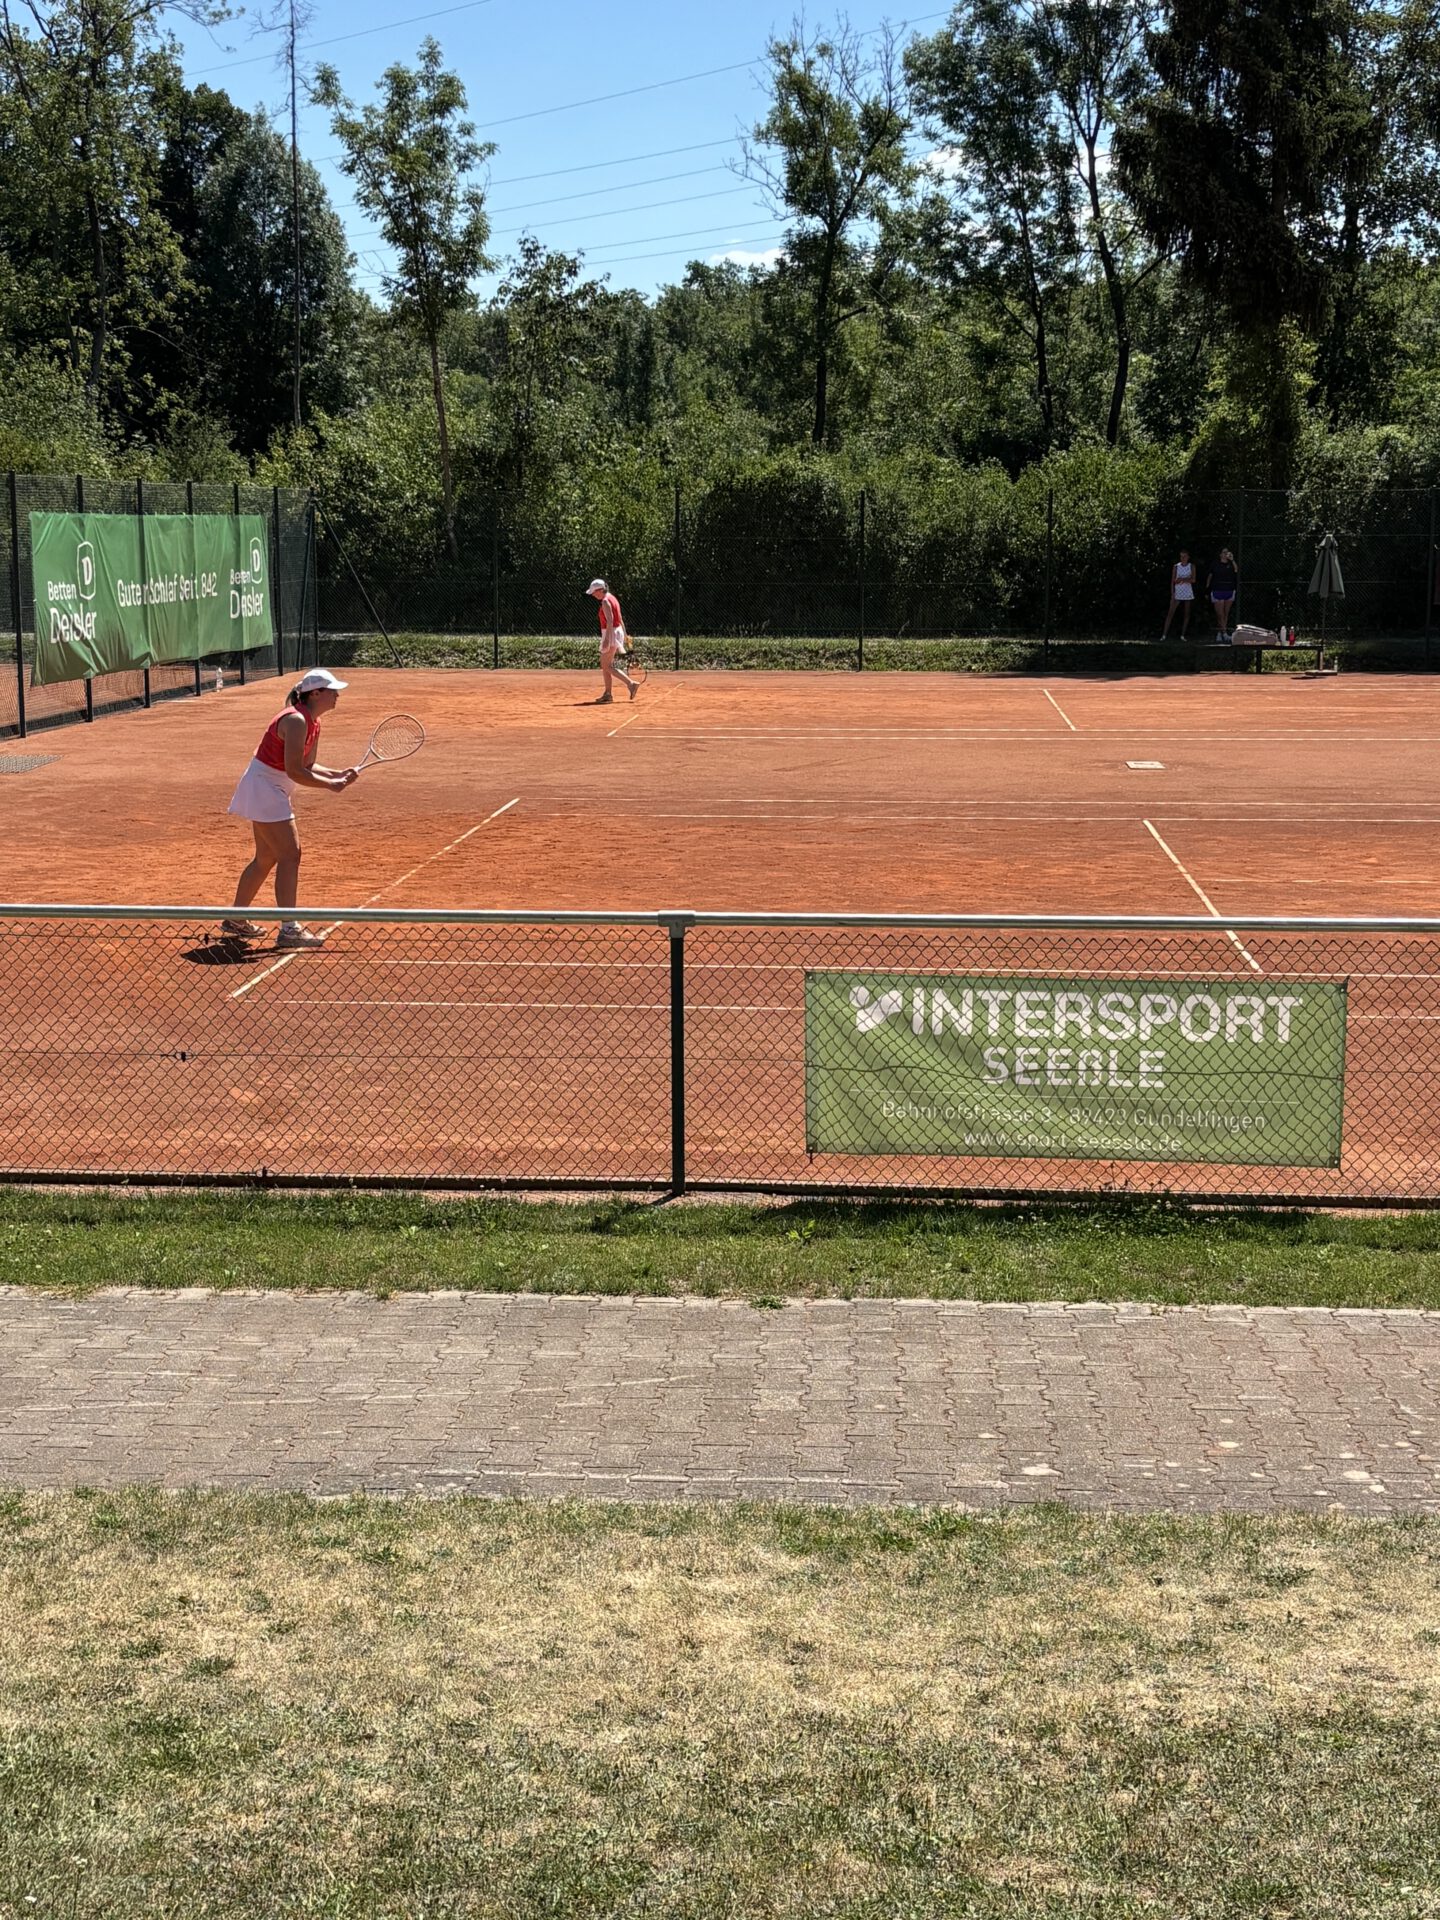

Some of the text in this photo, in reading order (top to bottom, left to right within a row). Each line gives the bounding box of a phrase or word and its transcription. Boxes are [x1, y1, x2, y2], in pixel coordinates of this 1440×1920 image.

[48, 580, 78, 601] Betten
[117, 579, 149, 607] Guter
[149, 573, 178, 605] Schlaf
[179, 573, 199, 601] Seit
[230, 569, 251, 585] Been
[50, 603, 97, 644] Deisler
[911, 987, 1303, 1044] INTERSPORT
[882, 1101, 1035, 1123] Bahnhofstrasse
[1068, 1107, 1128, 1126] 89423
[1134, 1108, 1266, 1133] Gundelfingen
[963, 1132, 1183, 1151] www.sportseessle.de
